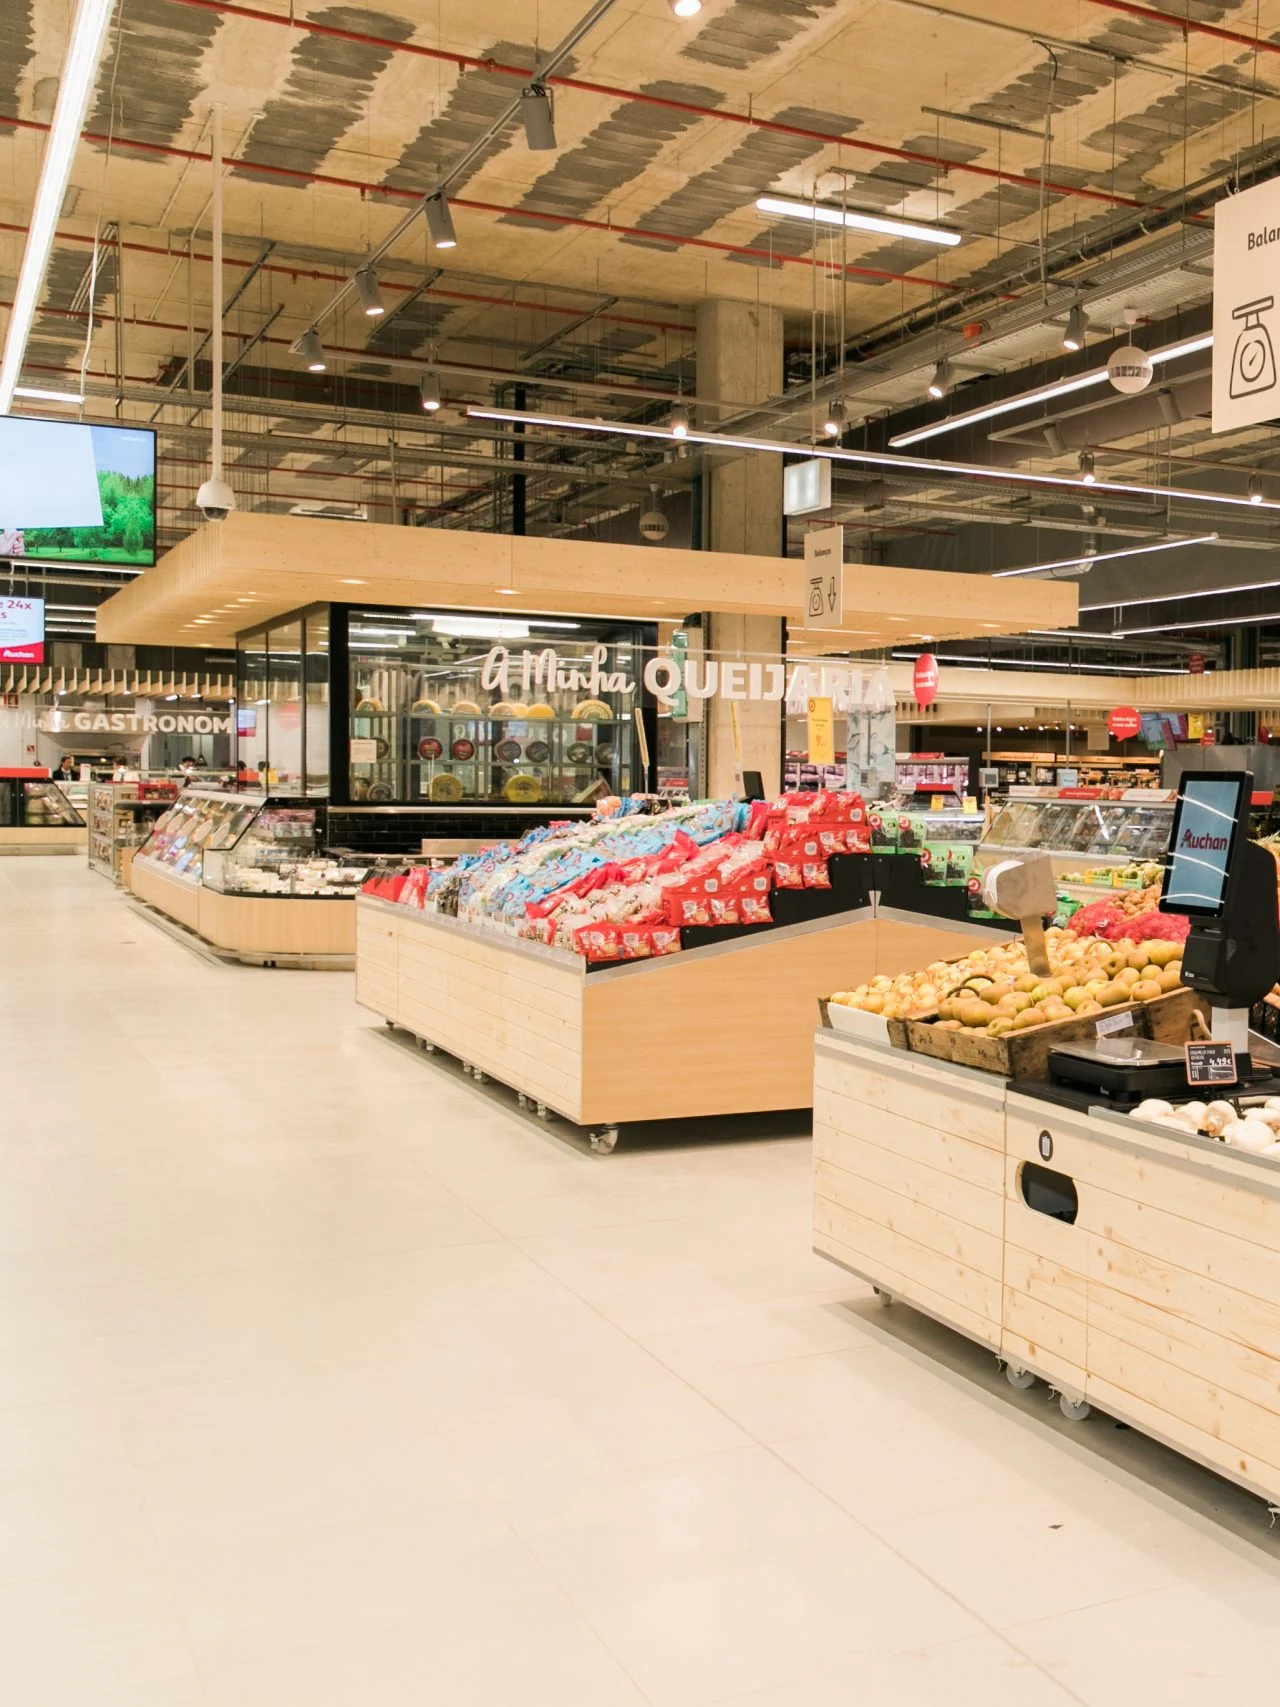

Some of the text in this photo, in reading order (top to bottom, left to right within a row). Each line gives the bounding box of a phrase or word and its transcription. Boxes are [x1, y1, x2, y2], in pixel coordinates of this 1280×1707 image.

[3, 649, 35, 659] Auchan
[522, 645, 636, 696] Minha
[644, 657, 897, 707] QUEIJARIA
[1180, 828, 1228, 851] Auchan
